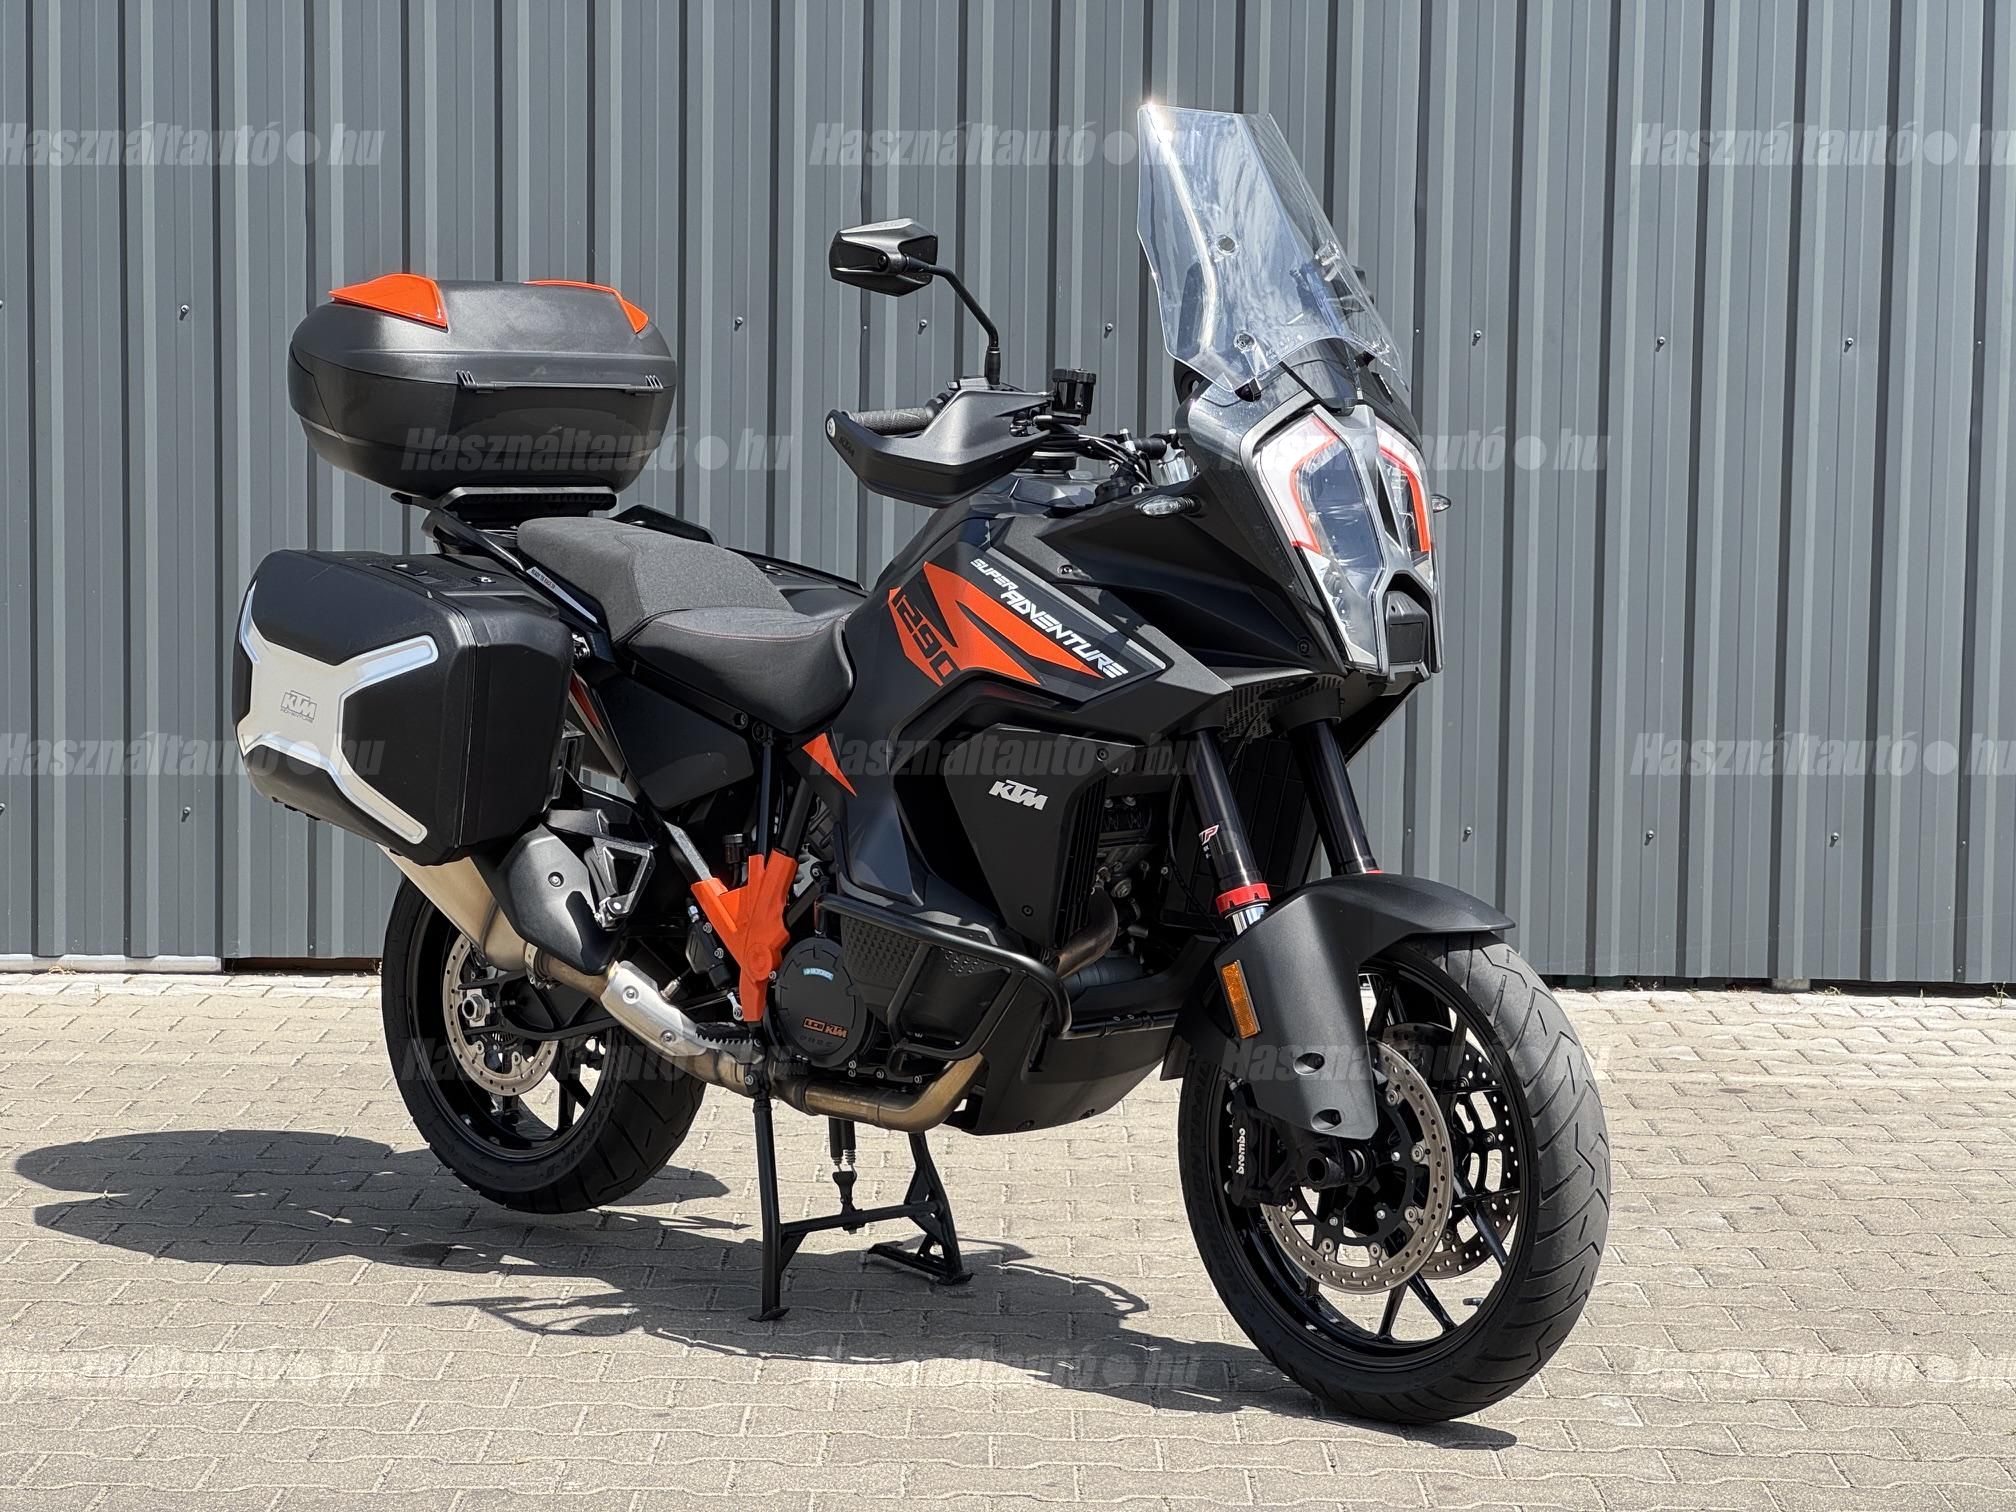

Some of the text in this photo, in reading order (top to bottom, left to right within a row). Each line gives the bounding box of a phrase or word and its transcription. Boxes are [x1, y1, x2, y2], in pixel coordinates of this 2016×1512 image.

[970, 558, 1019, 590] SUPER
[891, 589, 955, 678] 1290
[1000, 589, 1128, 679] ADVENTURE
[280, 689, 317, 720] KTM
[988, 779, 1049, 811] KTM
[1235, 1127, 1247, 1175] brembo
